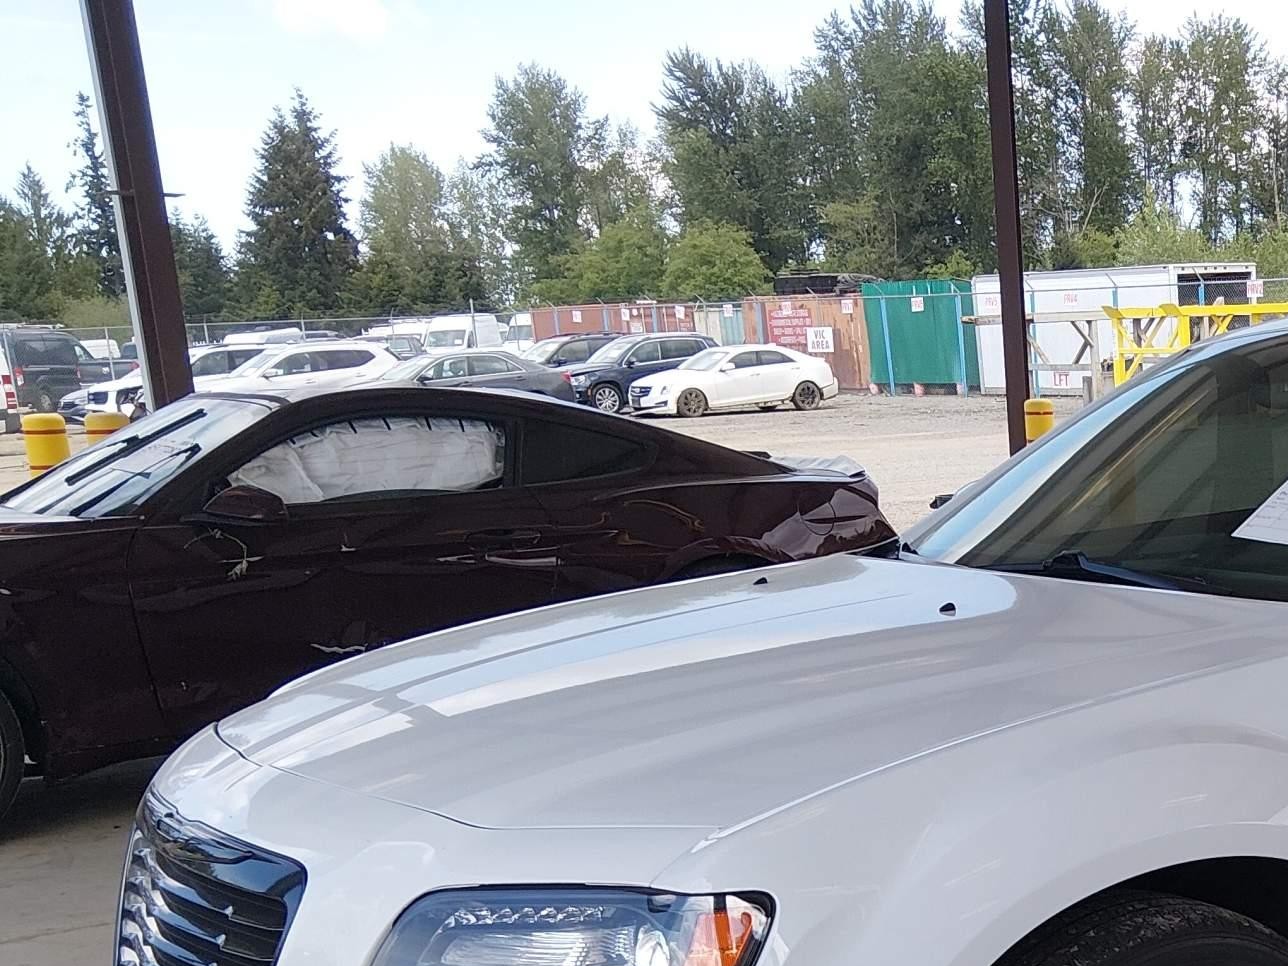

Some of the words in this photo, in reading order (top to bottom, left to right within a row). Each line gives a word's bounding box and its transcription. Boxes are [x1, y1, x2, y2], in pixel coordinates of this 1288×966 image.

[813, 329, 826, 340] VIC
[811, 340, 830, 350] AREA
[1053, 371, 1070, 387] LFT
